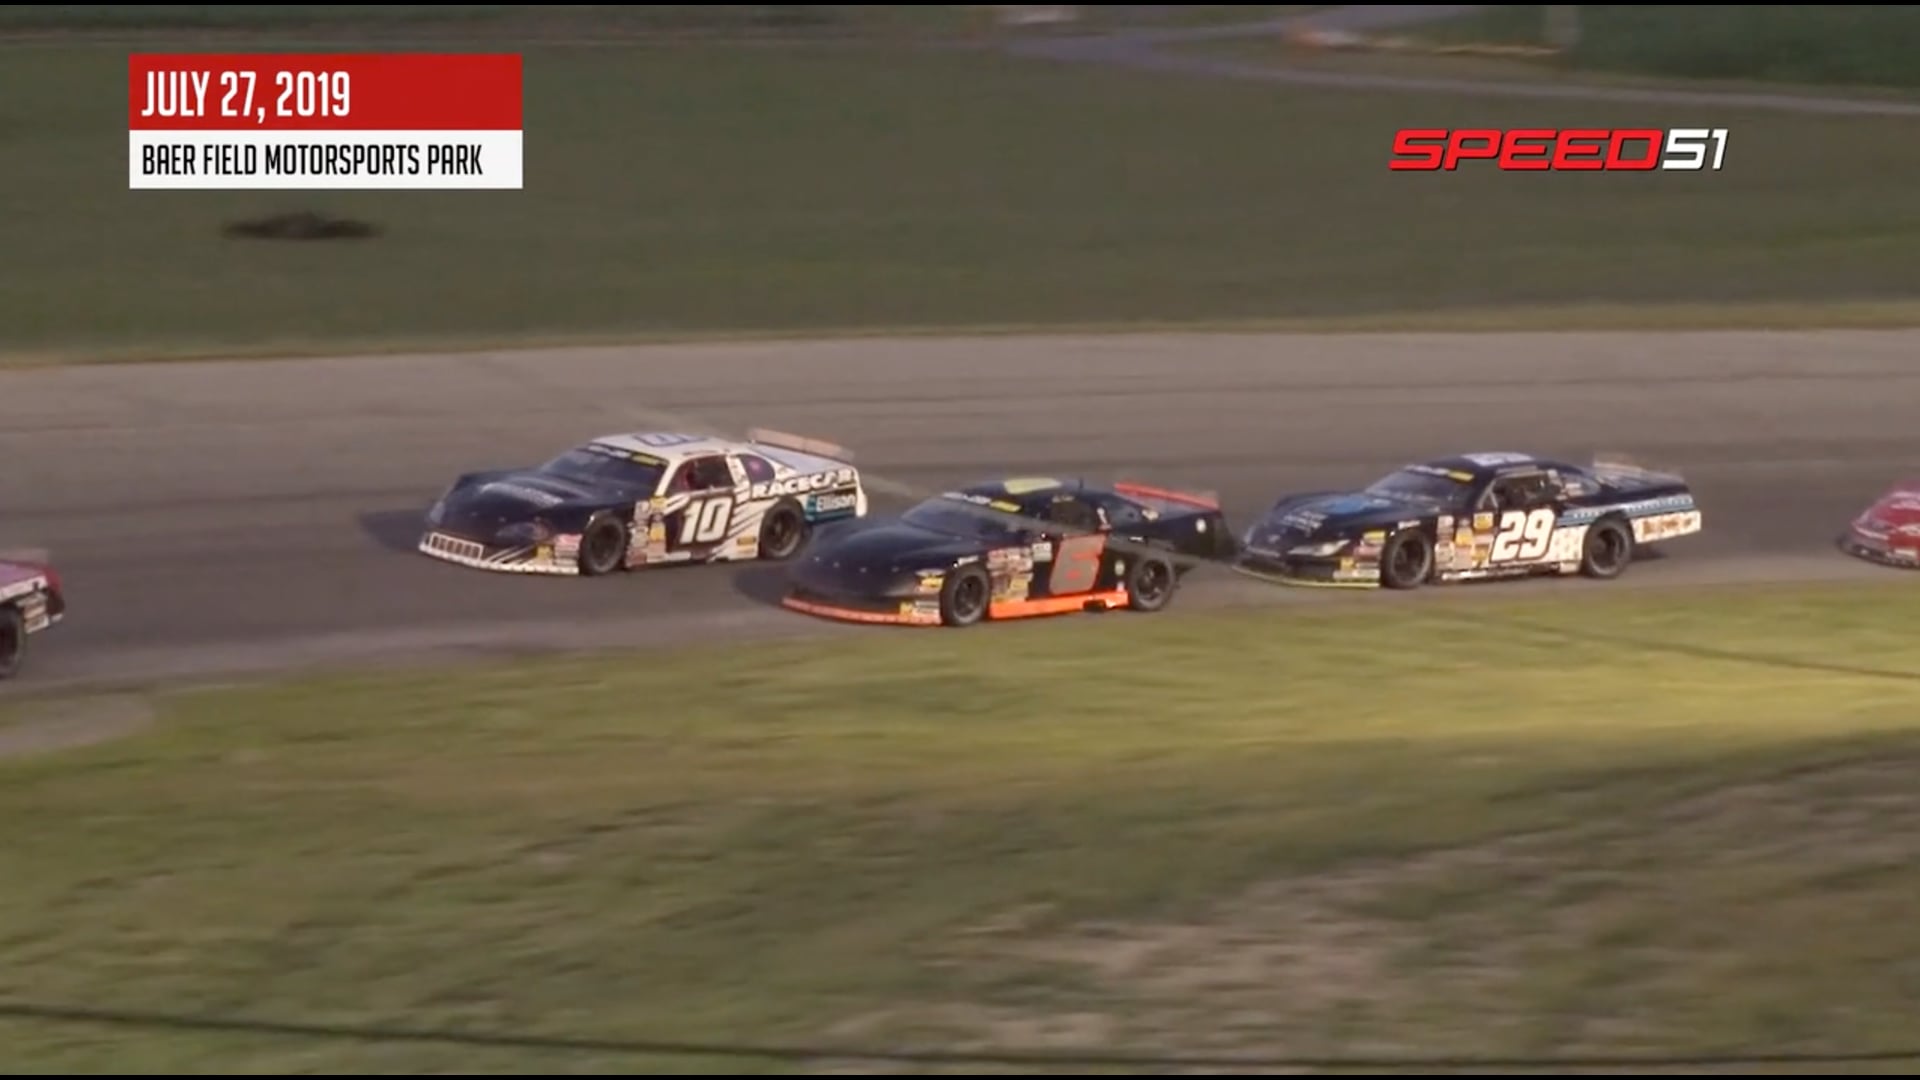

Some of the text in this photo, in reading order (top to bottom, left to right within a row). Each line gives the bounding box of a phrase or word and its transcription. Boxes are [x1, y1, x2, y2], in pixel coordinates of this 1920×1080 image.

[679, 496, 733, 545] 10
[816, 494, 857, 512] Ellison
[1490, 508, 1557, 562] 29
[1048, 534, 1107, 596] 6
